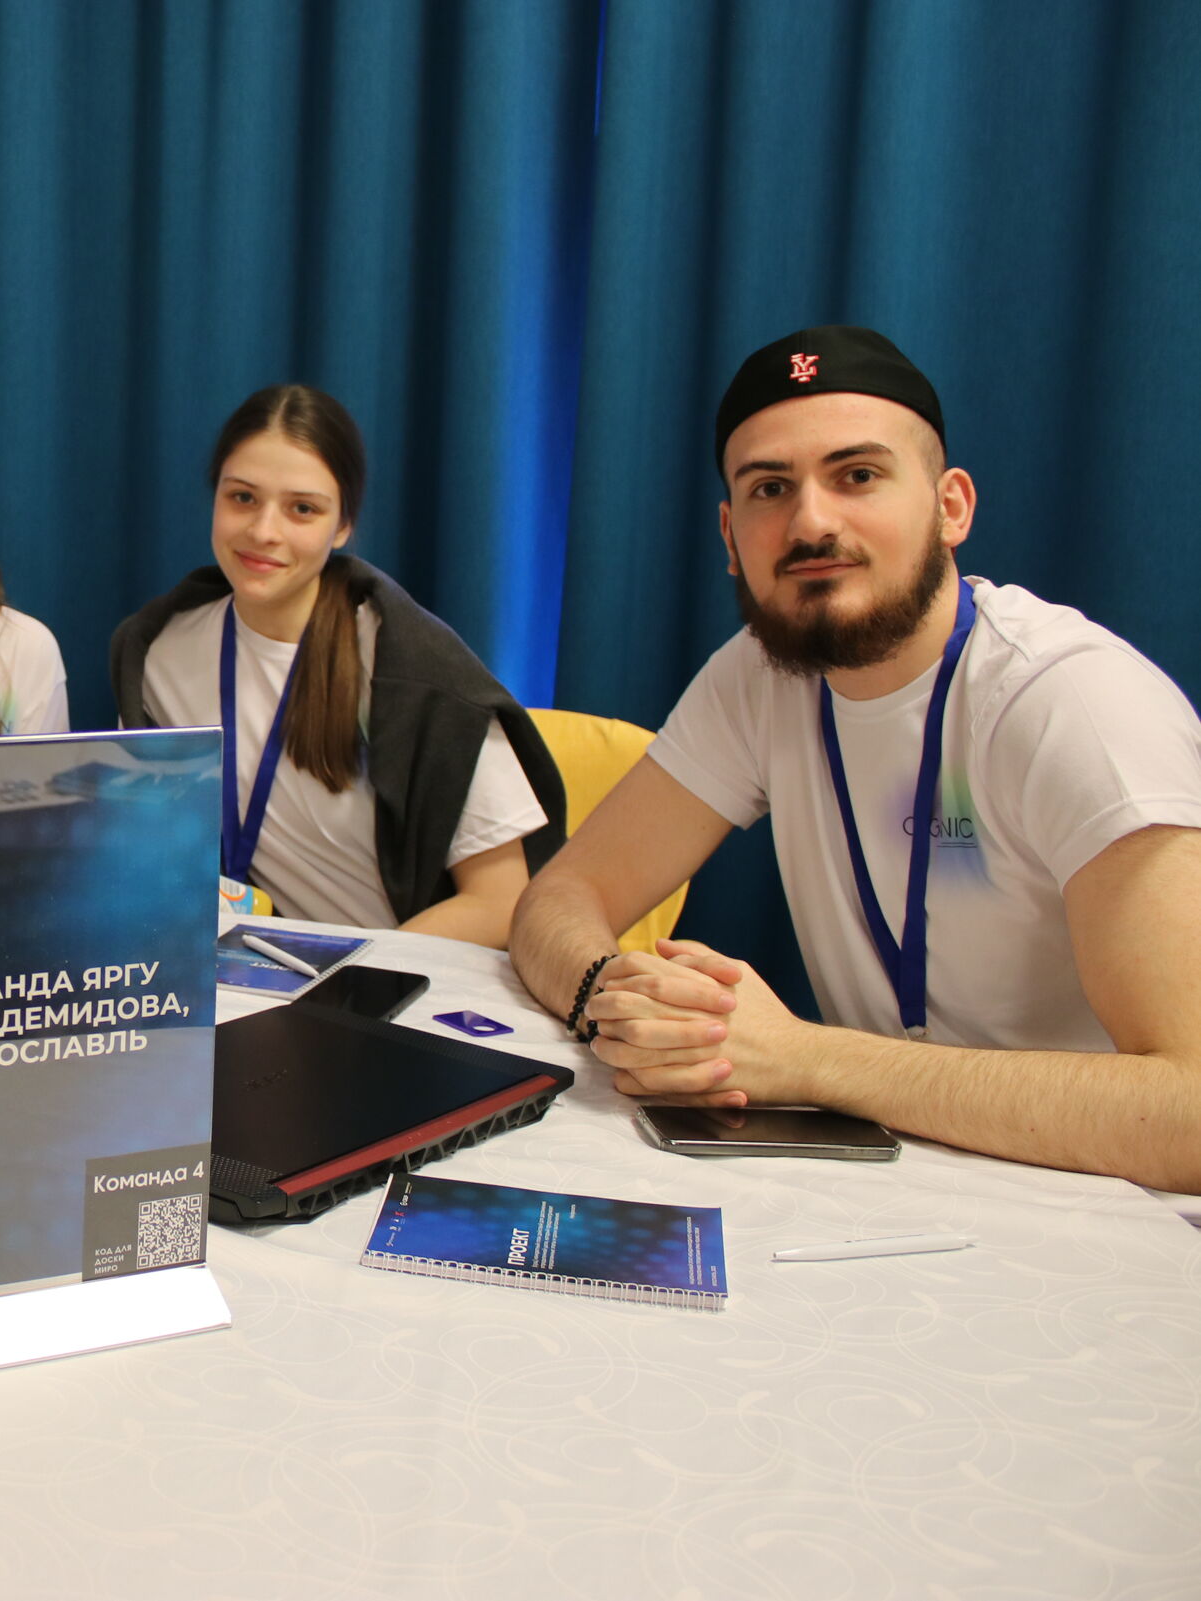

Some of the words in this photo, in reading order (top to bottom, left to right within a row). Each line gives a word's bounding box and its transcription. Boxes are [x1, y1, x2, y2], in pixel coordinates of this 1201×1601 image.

[82, 961, 160, 991] ЯРГУ
[0, 992, 190, 1037] ДЕМИДОВА,
[94, 1167, 188, 1194] Команда
[192, 1160, 204, 1179] 4
[94, 1254, 125, 1266] ДОСКИ
[95, 1247, 114, 1256] КОД
[115, 1244, 132, 1254] ДЛЯ
[507, 1228, 530, 1266] ПРОЕКТ
[94, 1264, 118, 1275] МИРО
